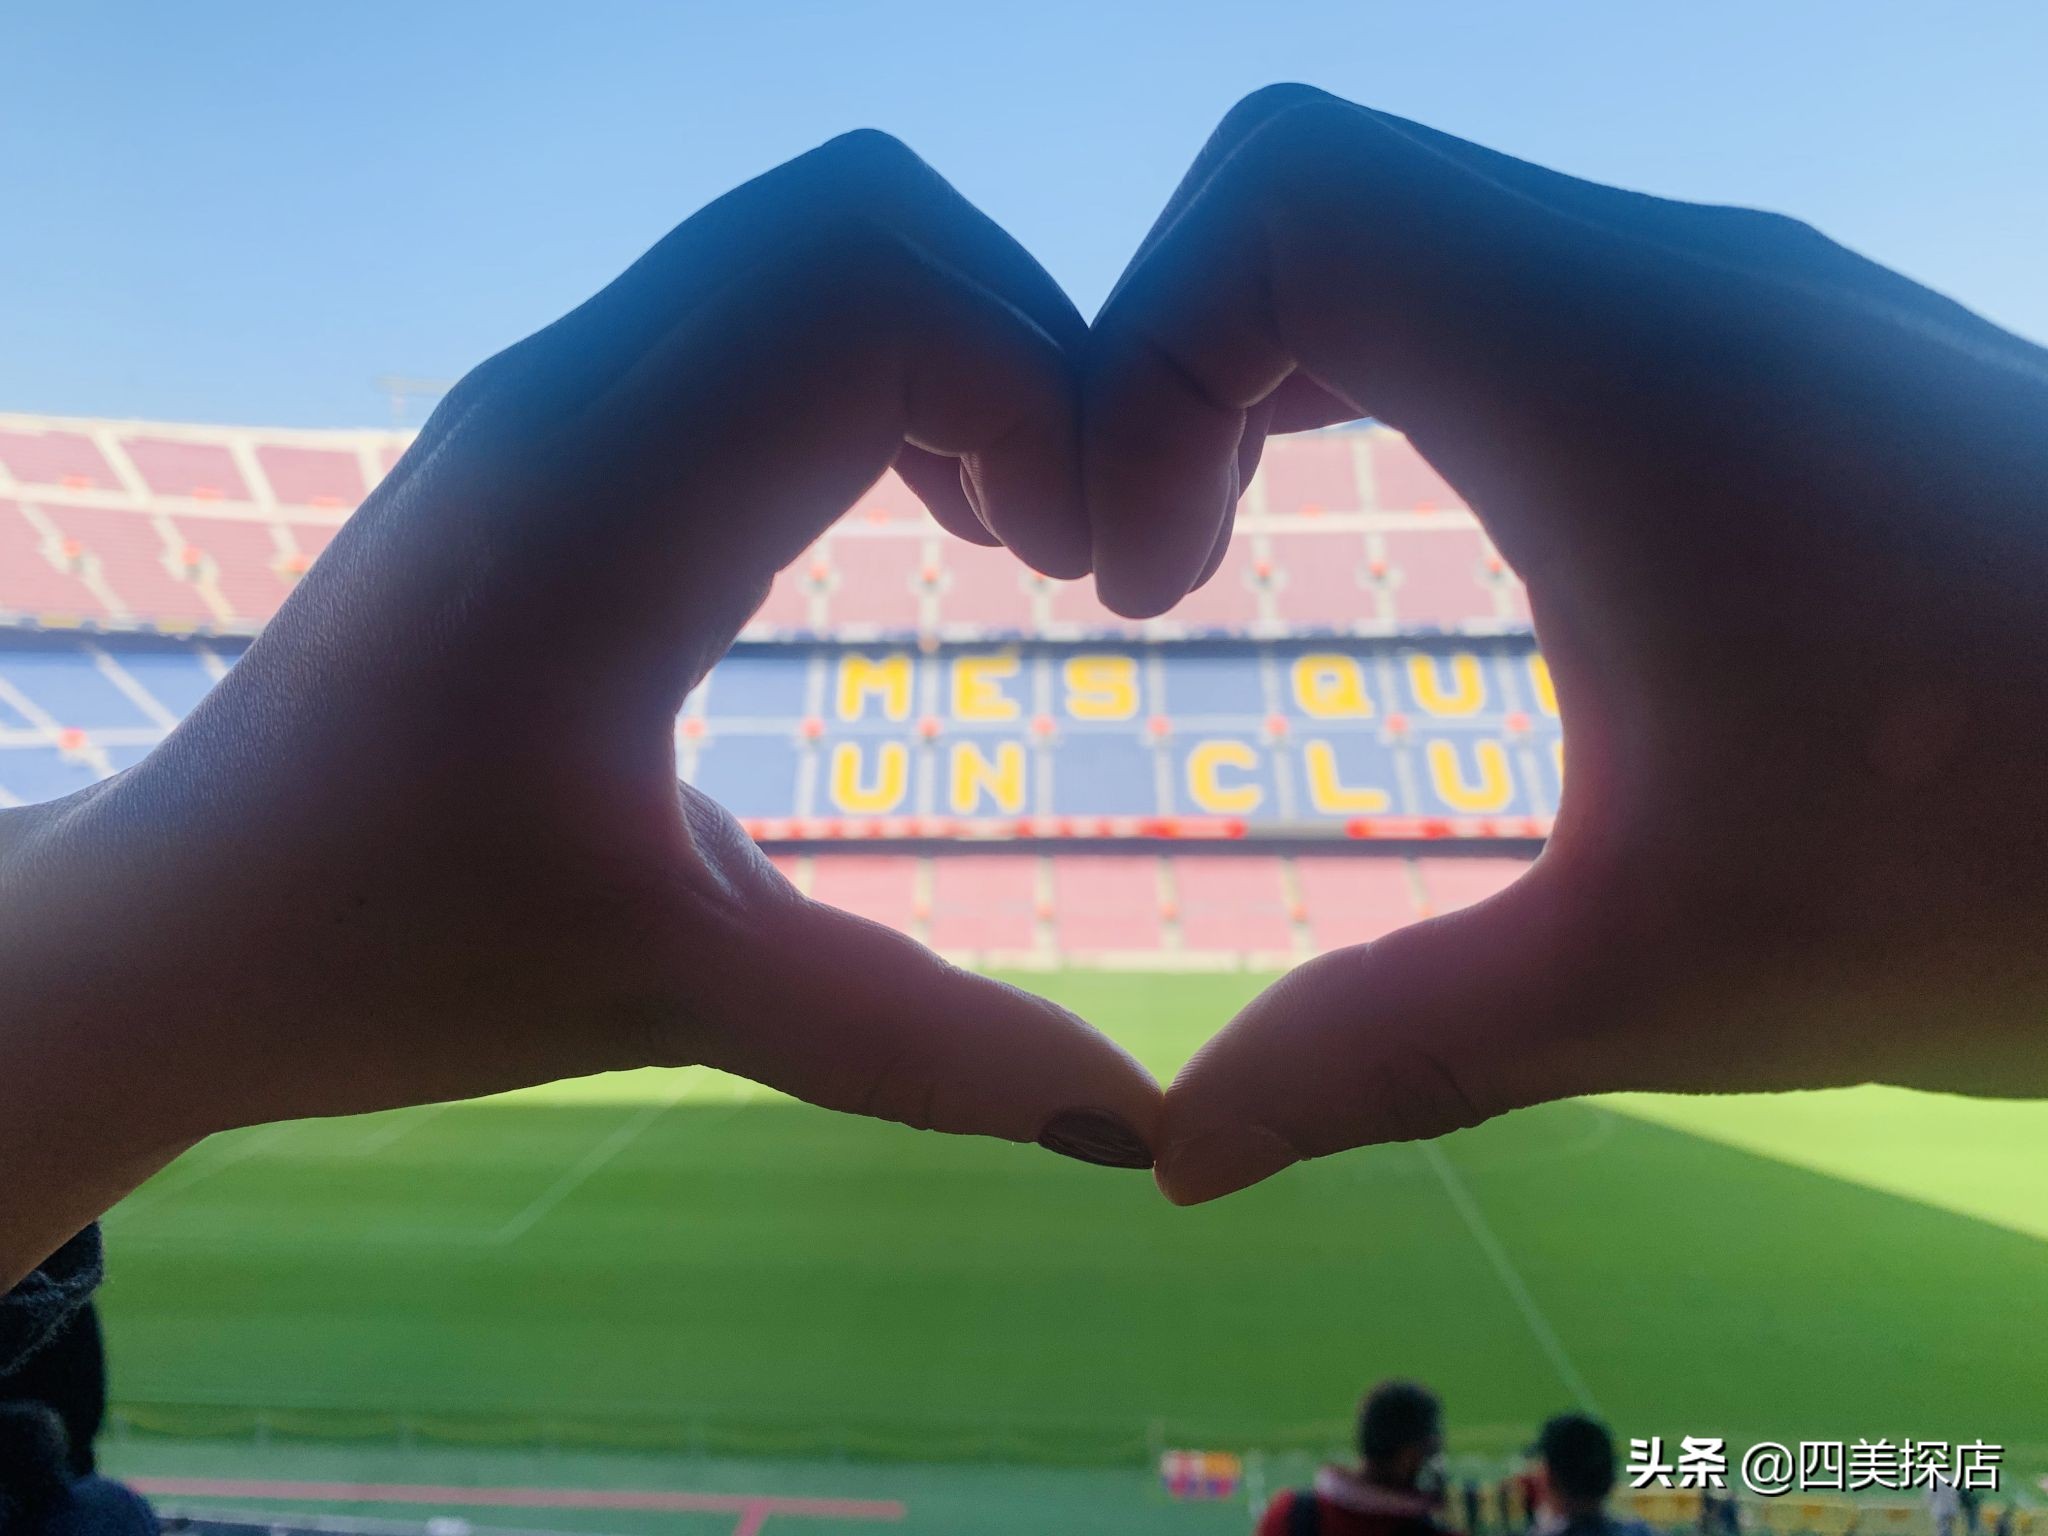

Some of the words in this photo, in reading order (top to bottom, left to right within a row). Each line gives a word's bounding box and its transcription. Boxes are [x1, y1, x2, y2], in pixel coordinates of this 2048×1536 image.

[838, 654, 1138, 720] MES
[832, 742, 1024, 813] UN
[1187, 739, 1563, 813] CLU
